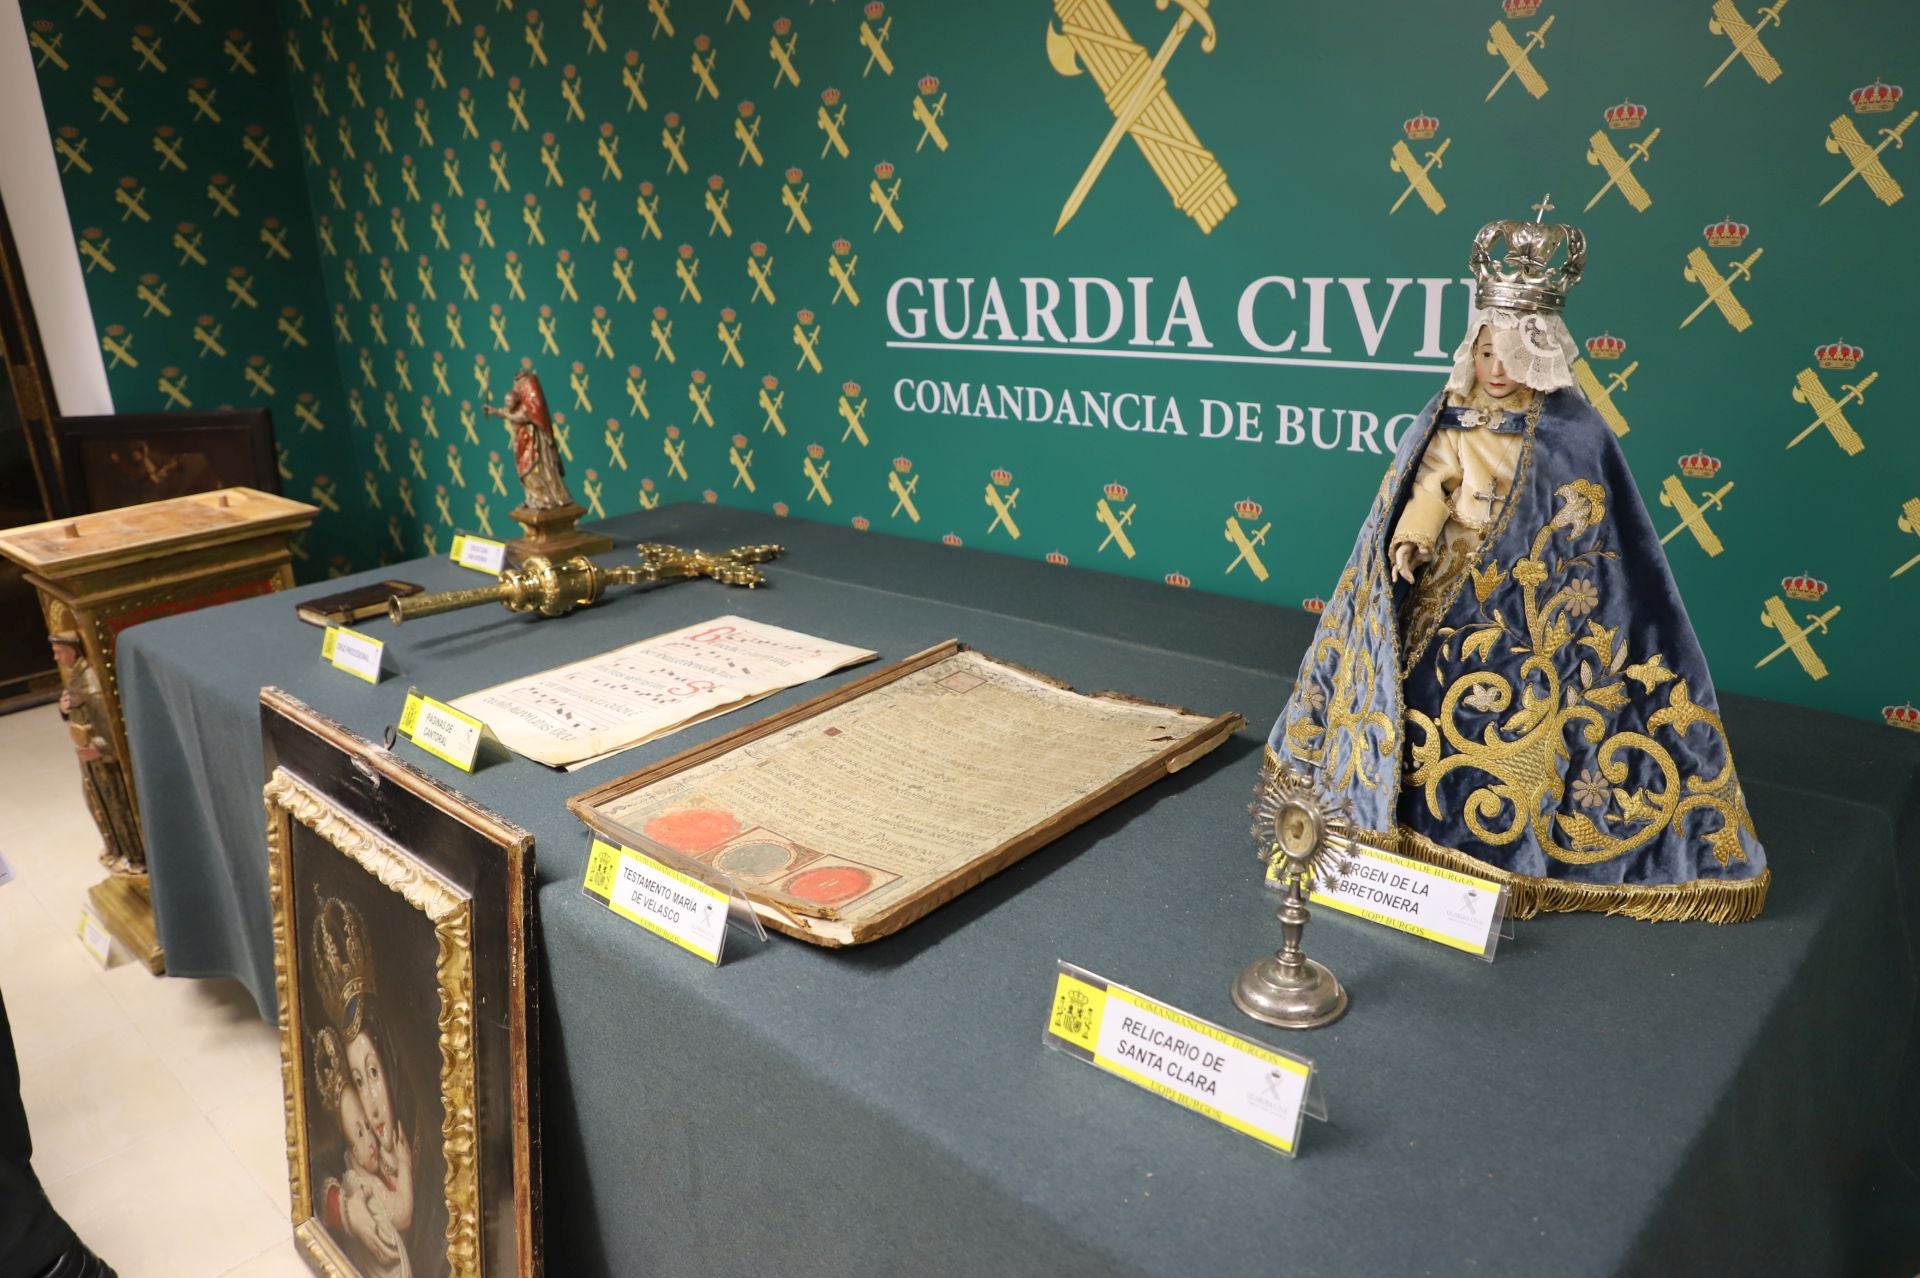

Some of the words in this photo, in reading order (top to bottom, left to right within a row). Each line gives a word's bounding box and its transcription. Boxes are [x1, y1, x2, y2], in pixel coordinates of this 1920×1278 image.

[886, 275, 1214, 349] GUARDIA
[892, 378, 1189, 437] COMANDANCIA
[1199, 398, 1264, 444] DE
[623, 867, 672, 900] TESTAMENTO
[672, 892, 698, 913] MARÍA
[1339, 879, 1420, 915] BRETONERA
[1342, 859, 1389, 884] RGEN
[1390, 874, 1410, 891] DE
[1411, 881, 1430, 897] LA
[631, 890, 643, 905] DE
[643, 896, 680, 923] VELASCO
[1117, 1039, 1163, 1072] SANTA
[1166, 1061, 1217, 1096] CLARA
[1121, 1016, 1200, 1061] RELICARIO
[1201, 1052, 1225, 1073] DE
